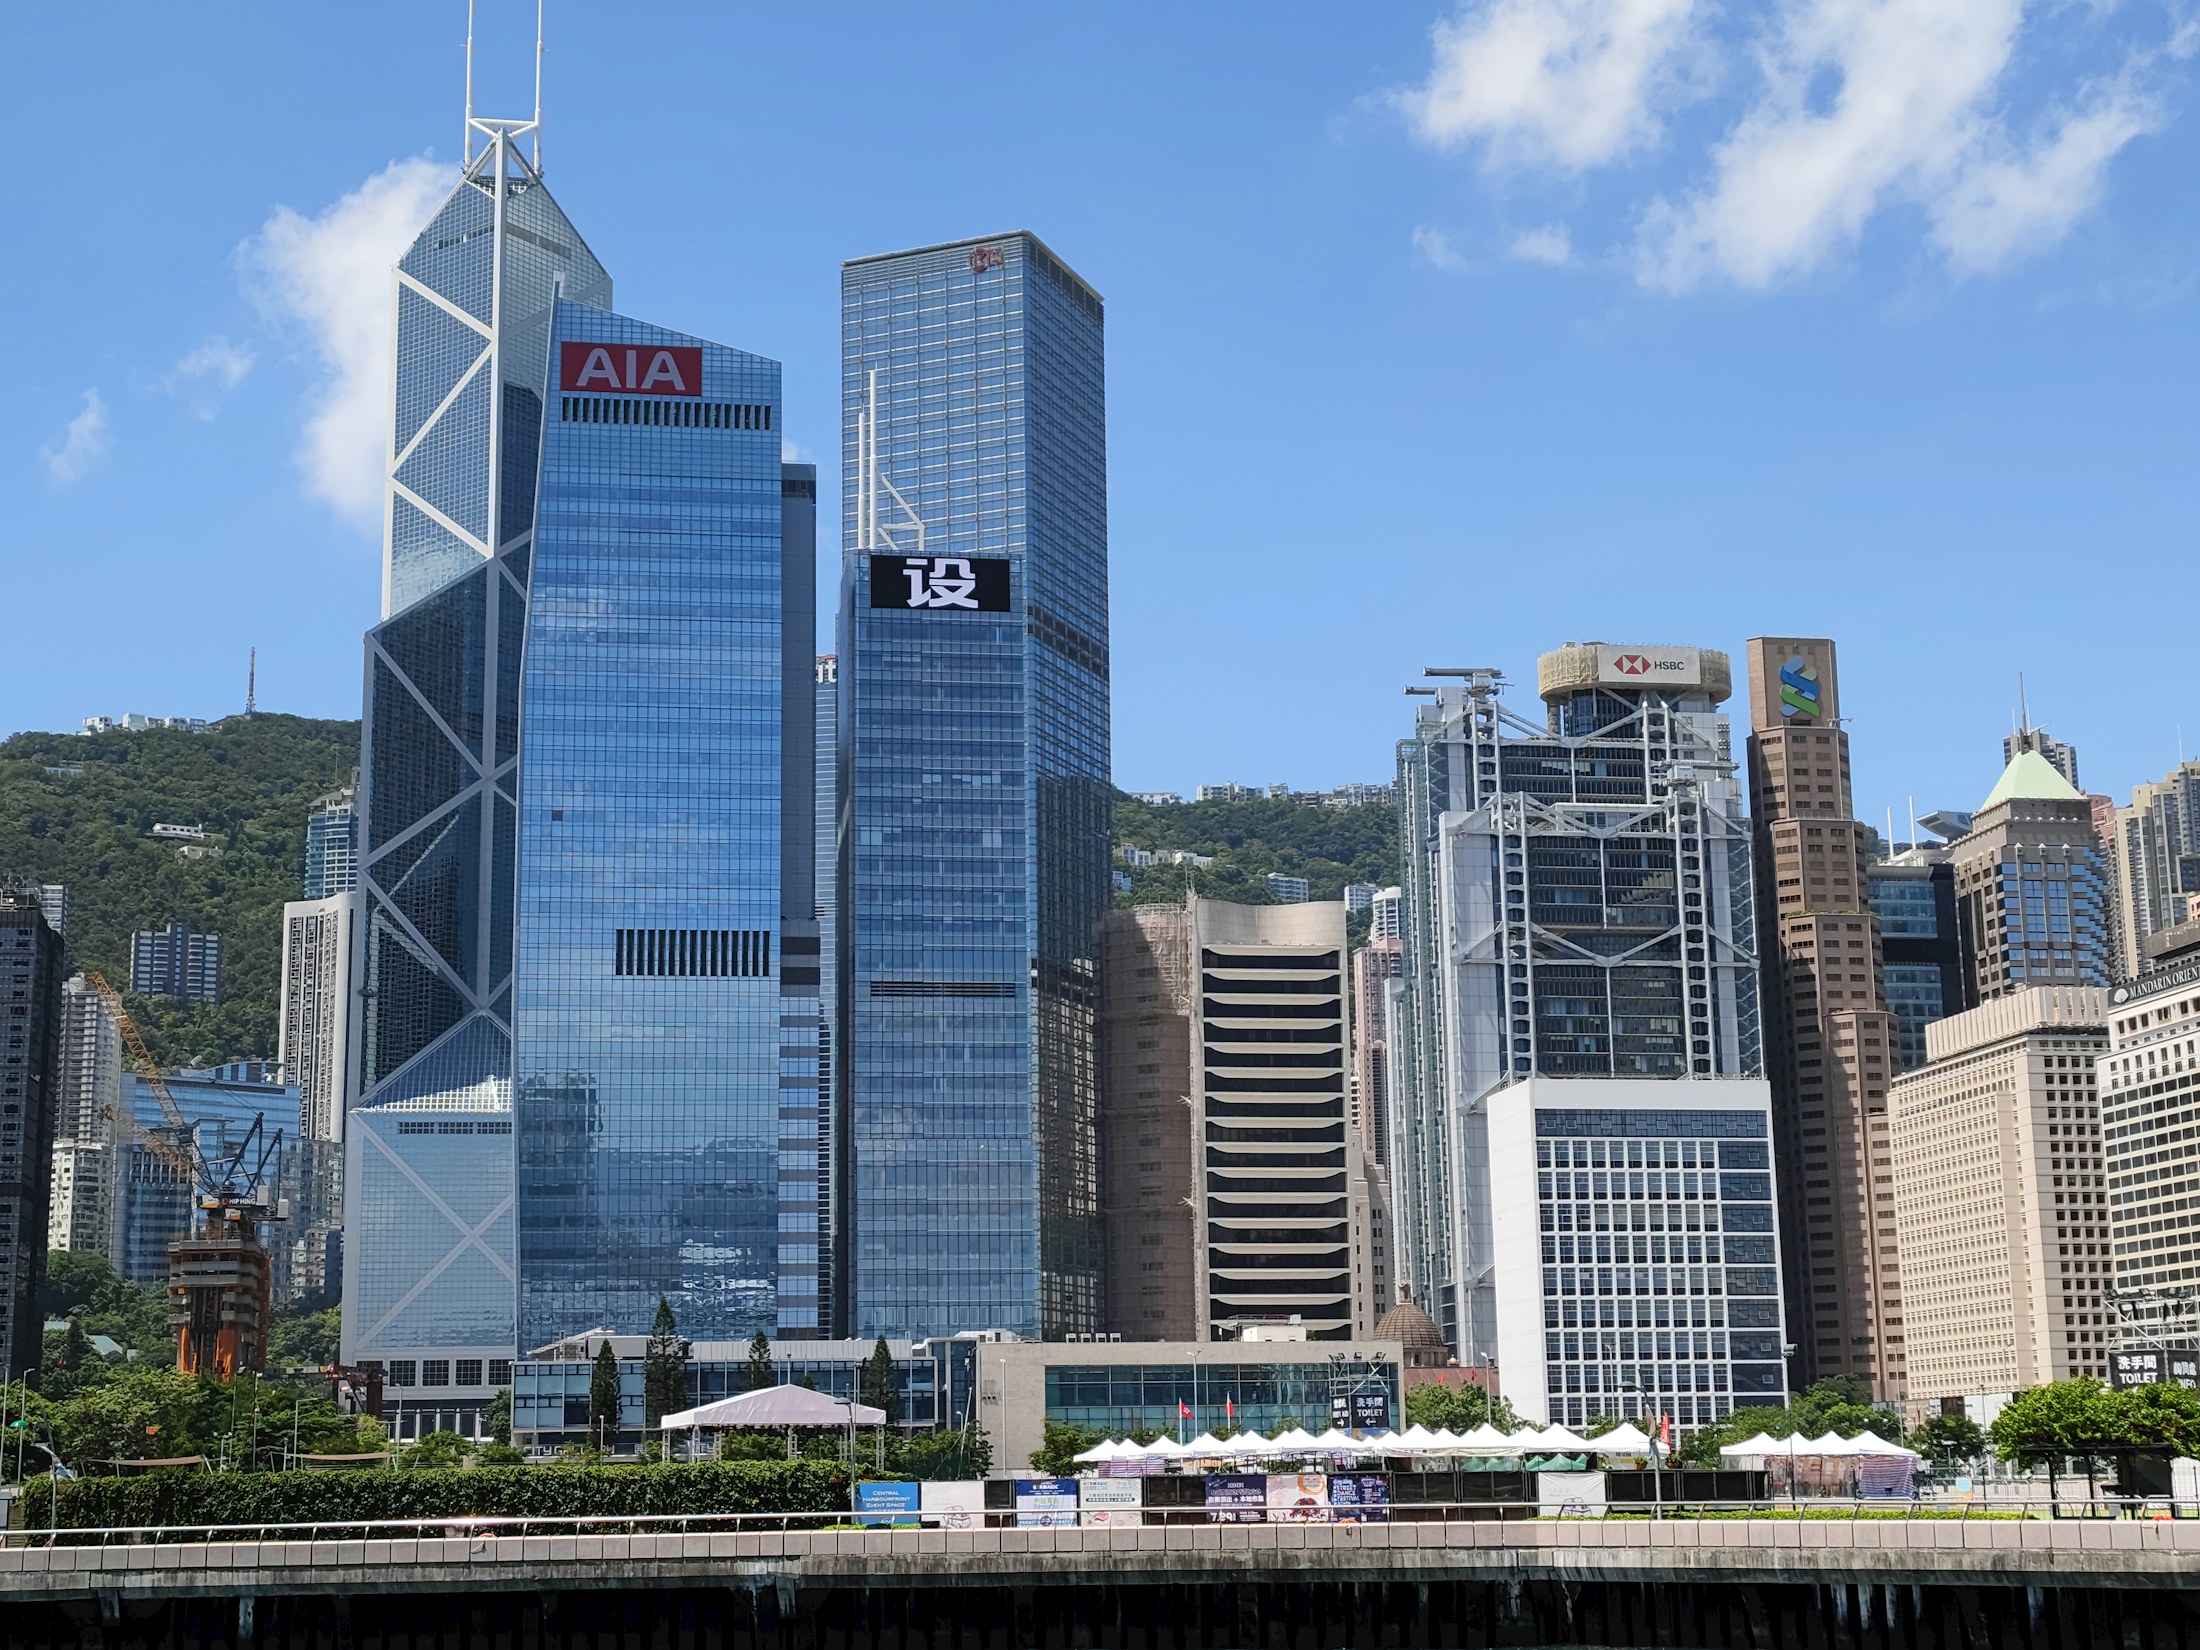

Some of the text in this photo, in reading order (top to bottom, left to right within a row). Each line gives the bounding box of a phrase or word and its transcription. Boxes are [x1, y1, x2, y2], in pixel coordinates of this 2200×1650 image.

[575, 347, 687, 391] AIA
[902, 557, 979, 609] 设
[1654, 660, 1685, 671] HSBC
[2129, 974, 2173, 999] MANDARIN
[2117, 1354, 2158, 1370] 洗手間
[2118, 1371, 2159, 1385] TOILET
[1356, 1396, 1384, 1408] 洗手間
[1356, 1408, 1384, 1417] TOILET
[523, 1445, 552, 1456] CITY
